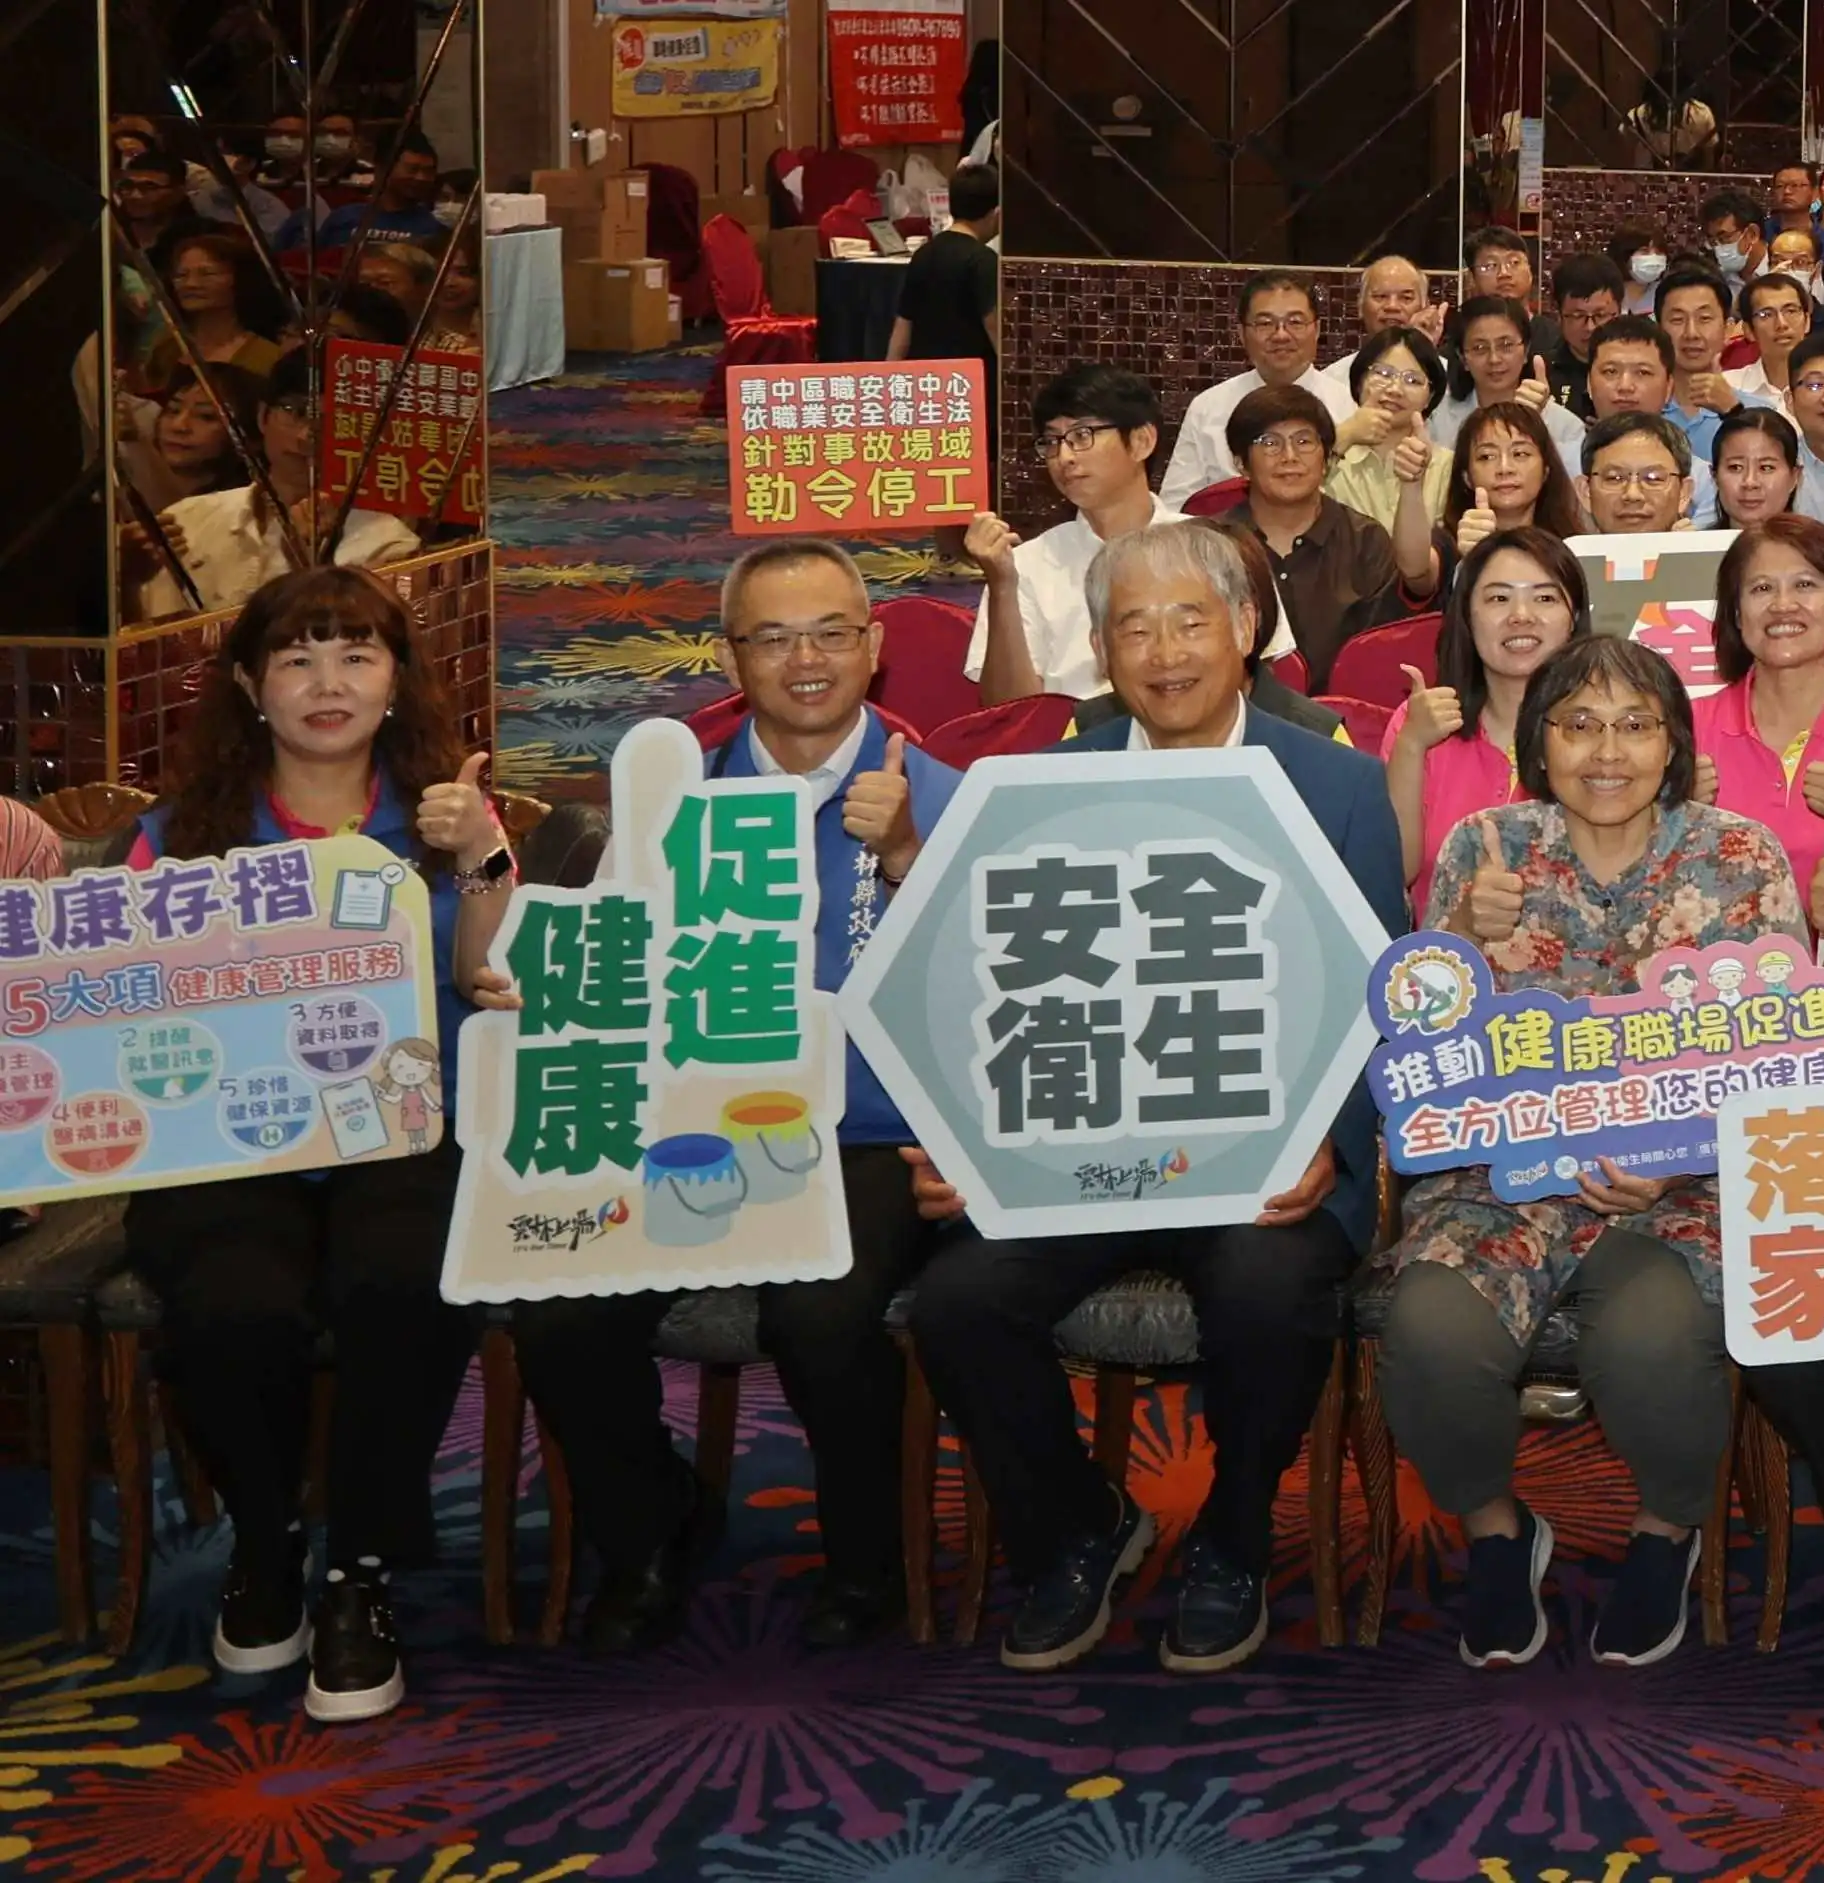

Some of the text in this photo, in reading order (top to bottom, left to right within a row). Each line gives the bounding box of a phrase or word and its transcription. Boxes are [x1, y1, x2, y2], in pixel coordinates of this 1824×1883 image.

[740, 372, 971, 404] 請中區職安衛中心
[741, 399, 972, 432] 依職業安全衛生法
[743, 427, 972, 469] 針對事故場域
[745, 467, 976, 523] 勒令停工
[662, 791, 804, 1071] 促進
[985, 851, 1267, 992] 安全
[169, 942, 402, 1006] 健康管理服務
[317, 1001, 358, 1022] 方便
[296, 1021, 380, 1047] 資料取得
[503, 893, 653, 1179] 健康
[984, 989, 1271, 1134] 衛生
[247, 1075, 289, 1097] 珍惜
[76, 1098, 119, 1120] 便利
[226, 1095, 313, 1122] 健保資源
